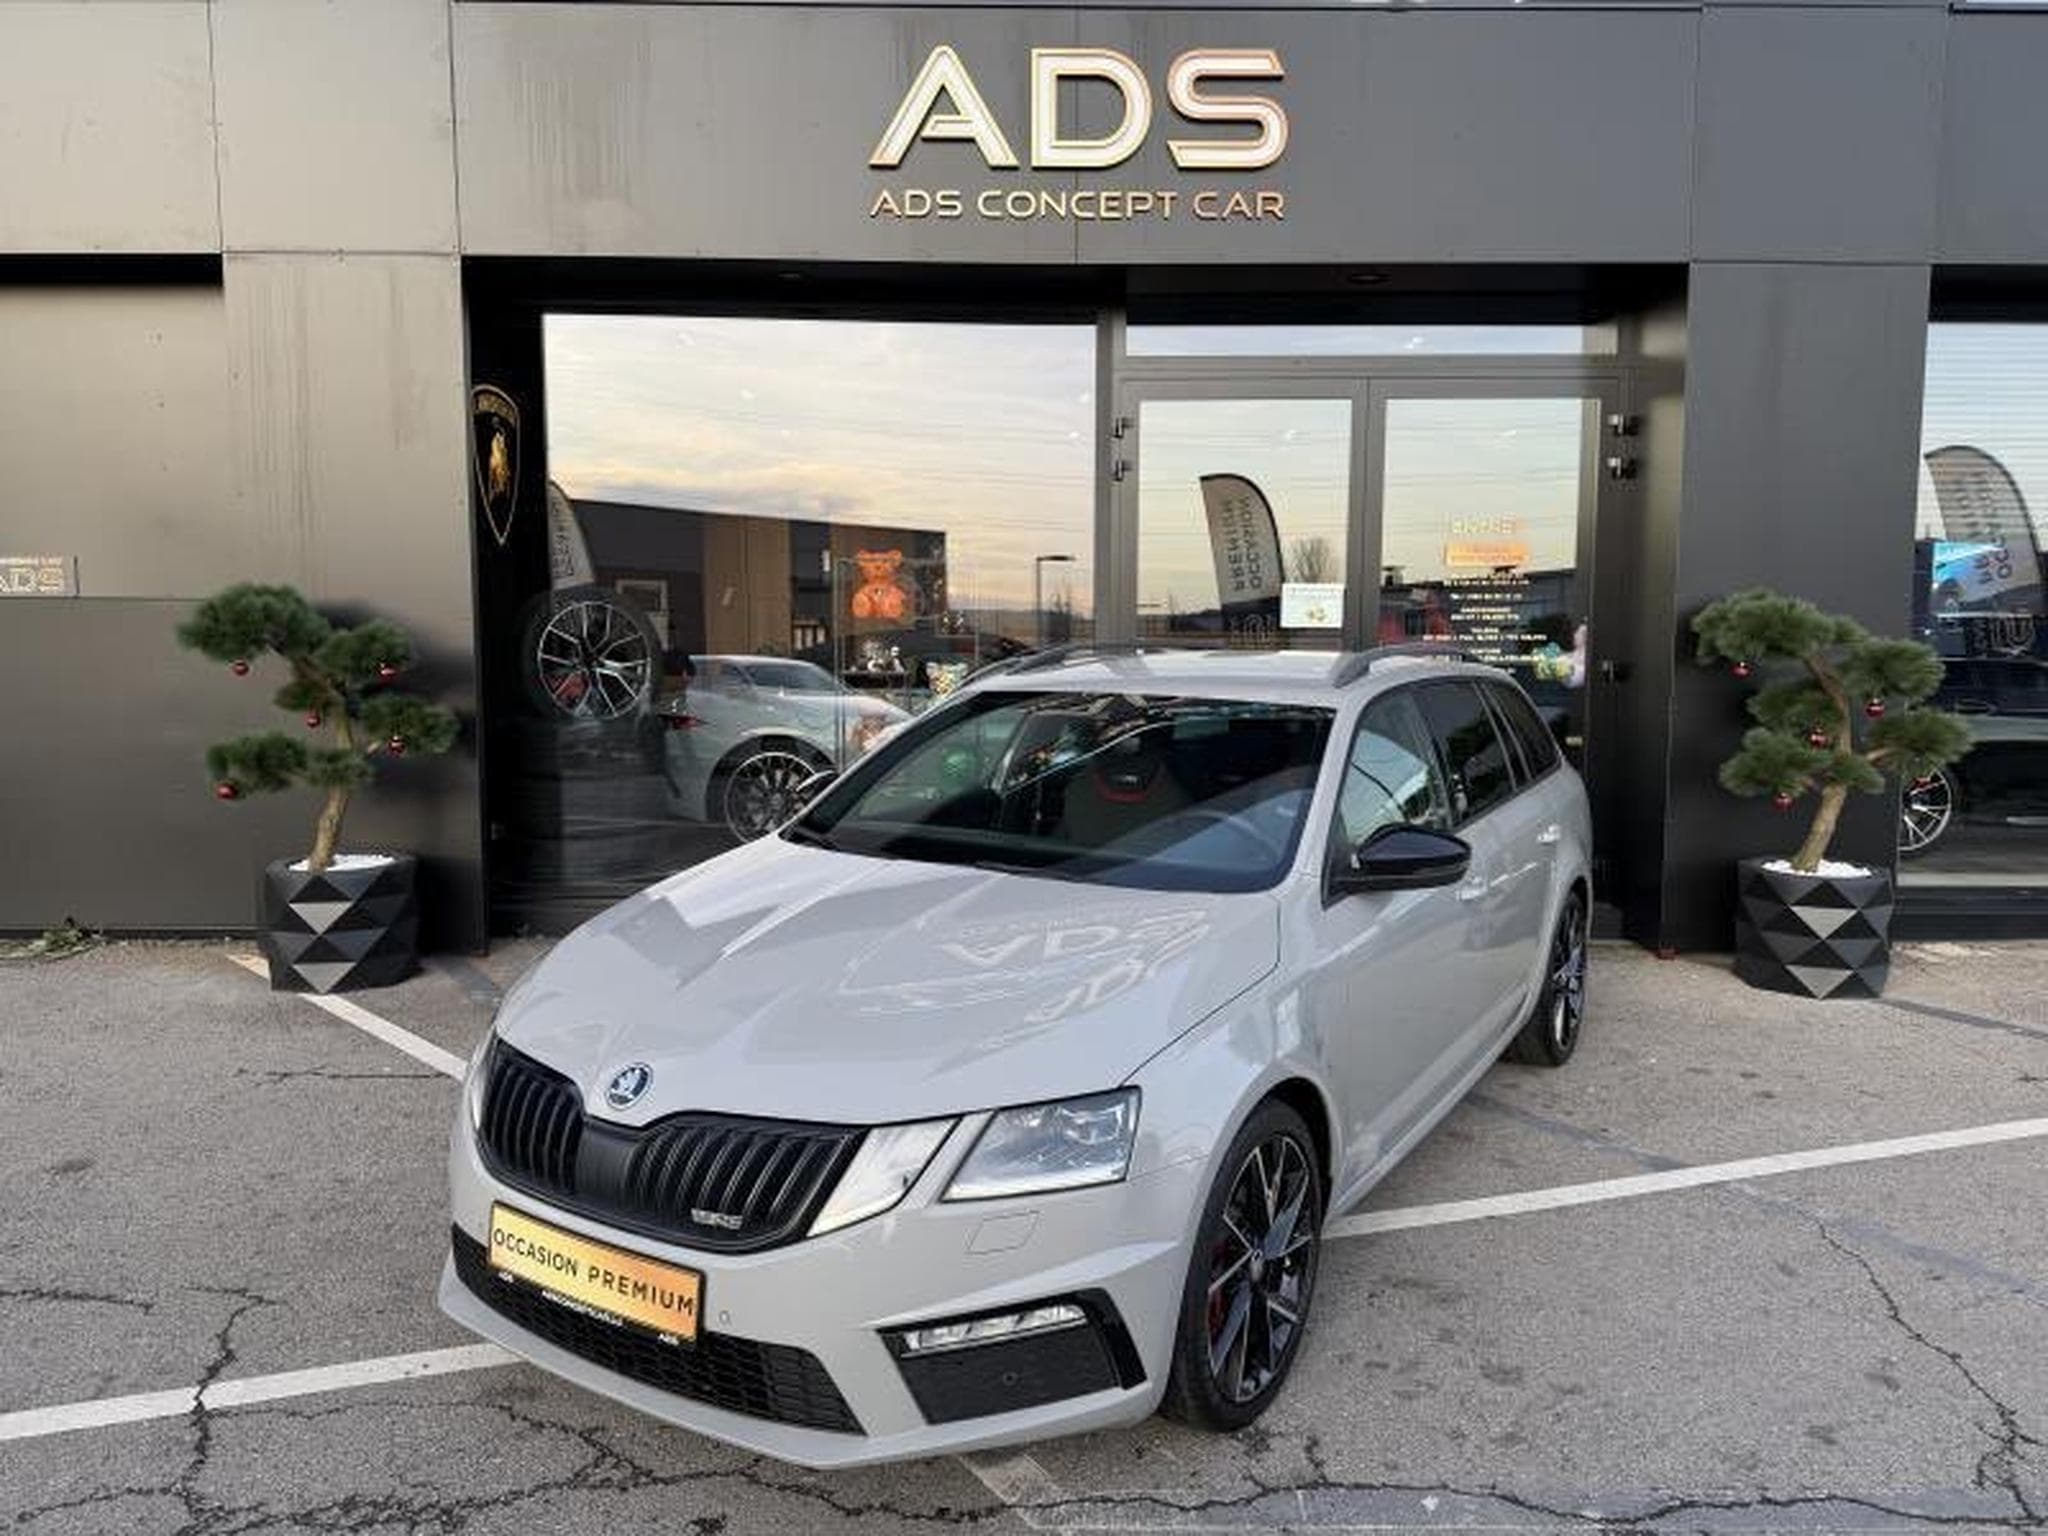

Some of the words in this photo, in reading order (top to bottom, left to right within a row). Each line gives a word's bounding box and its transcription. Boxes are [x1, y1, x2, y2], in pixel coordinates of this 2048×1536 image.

[868, 44, 1290, 170] ADS
[869, 189, 962, 218] ADS
[977, 189, 1178, 219] CONCEPT
[1193, 189, 1287, 220] CAR
[493, 1227, 578, 1277] OCCASION
[587, 1265, 695, 1317] PREMIUM
